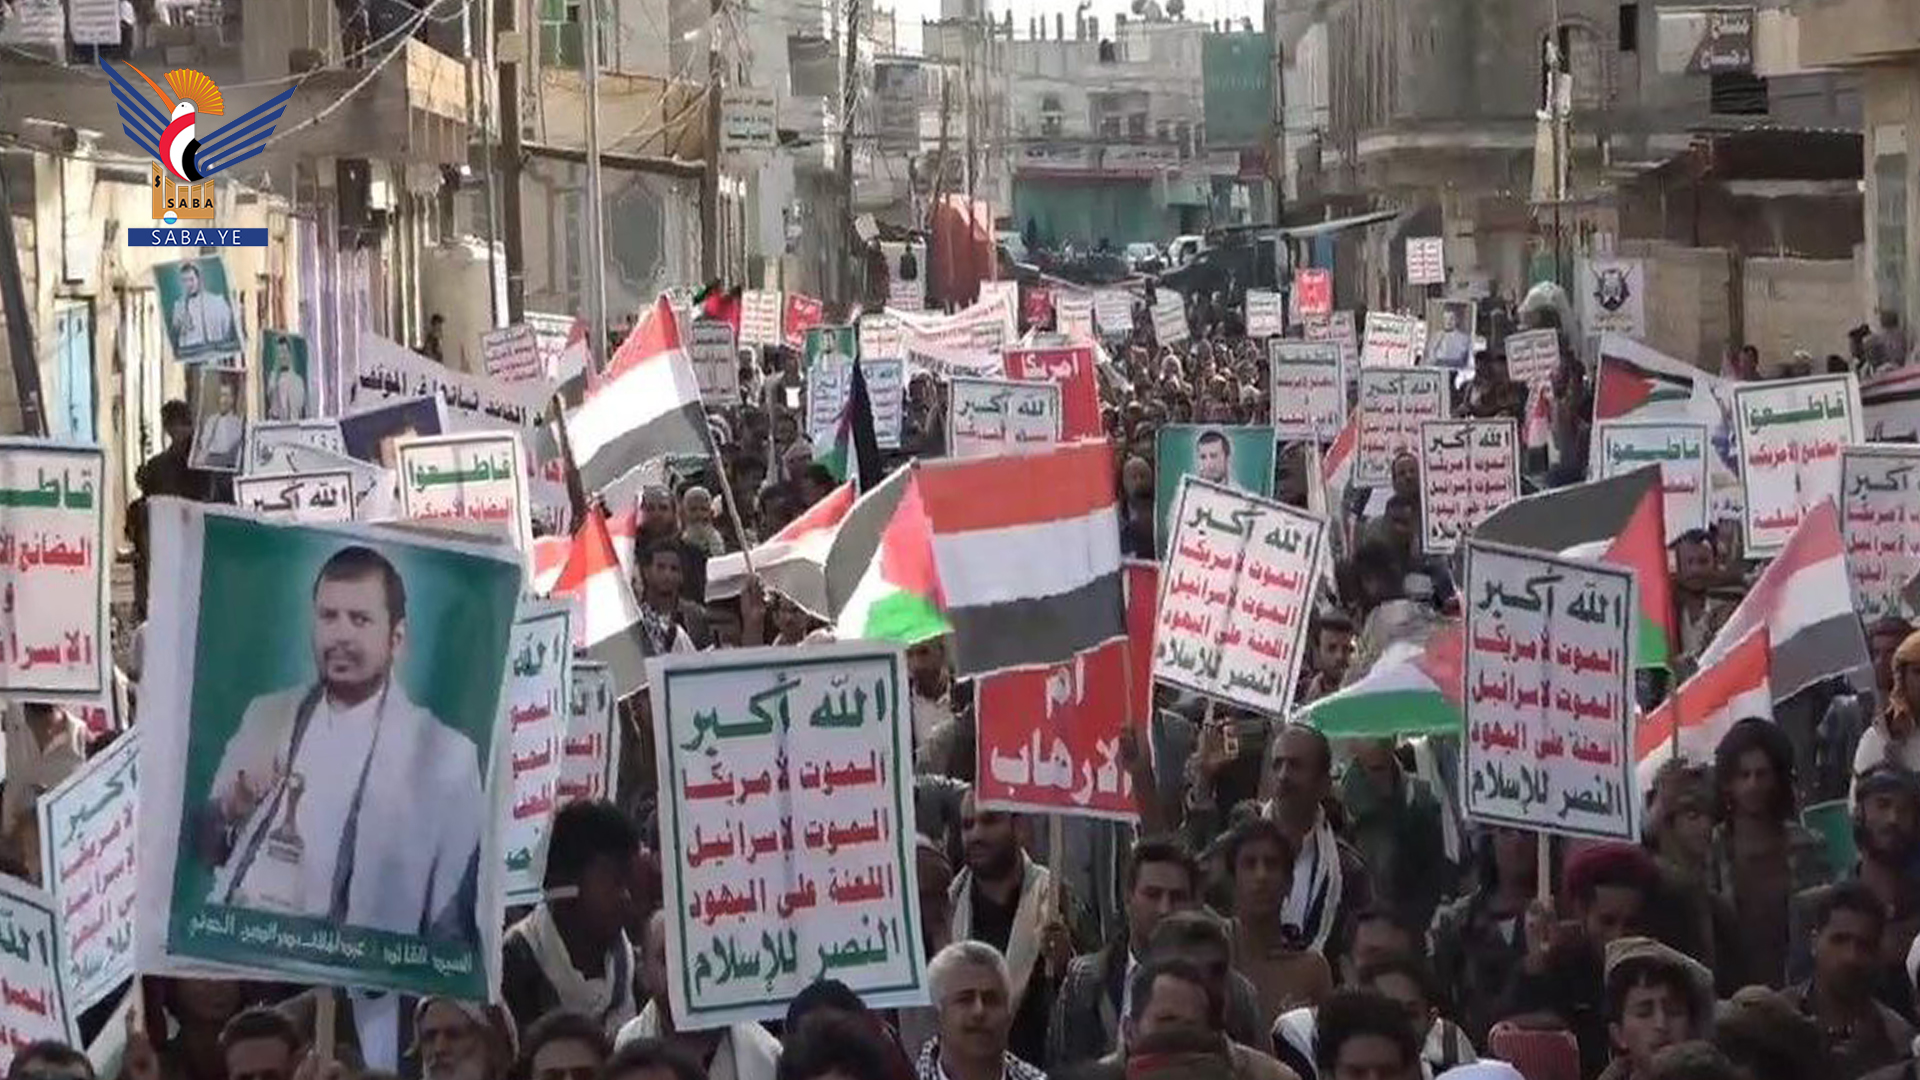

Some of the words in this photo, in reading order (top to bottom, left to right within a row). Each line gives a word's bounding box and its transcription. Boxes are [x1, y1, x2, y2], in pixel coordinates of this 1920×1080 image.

[1743, 390, 1845, 435] قاطعوا
[408, 451, 512, 492] قاطعوا
[309, 481, 348, 509] الله
[1185, 502, 1268, 542] أكبر
[1264, 522, 1312, 560] الله
[18, 532, 92, 573] البضائع
[1178, 532, 1246, 573] لأمريكا
[1248, 561, 1304, 596] الموت
[1478, 566, 1564, 618] أكبر
[1163, 610, 1211, 638] اليهود
[1241, 595, 1298, 628] الموت
[1566, 581, 1621, 628] الله
[1248, 627, 1290, 661] اللعنة
[1473, 622, 1551, 664] لأمريكا
[1556, 642, 1620, 676] الموت
[1221, 663, 1283, 697] النصر
[680, 670, 802, 758] أكبر
[809, 674, 887, 728] الله
[1556, 687, 1619, 722] الموت
[1471, 719, 1528, 756] اليهود
[1534, 726, 1565, 760] على
[1568, 730, 1620, 768] اللعنة
[681, 745, 790, 807] لأمريكا
[799, 750, 887, 796] الموت
[1471, 759, 1549, 815] للإسلام
[1557, 775, 1623, 820] النصر
[686, 815, 795, 869] لإسرائيل
[803, 808, 890, 856] الموت
[689, 877, 767, 927] اليهود
[776, 873, 818, 919] على
[827, 863, 895, 904] اللعنة
[694, 926, 799, 997] للإسلام
[816, 914, 901, 982] النصر
